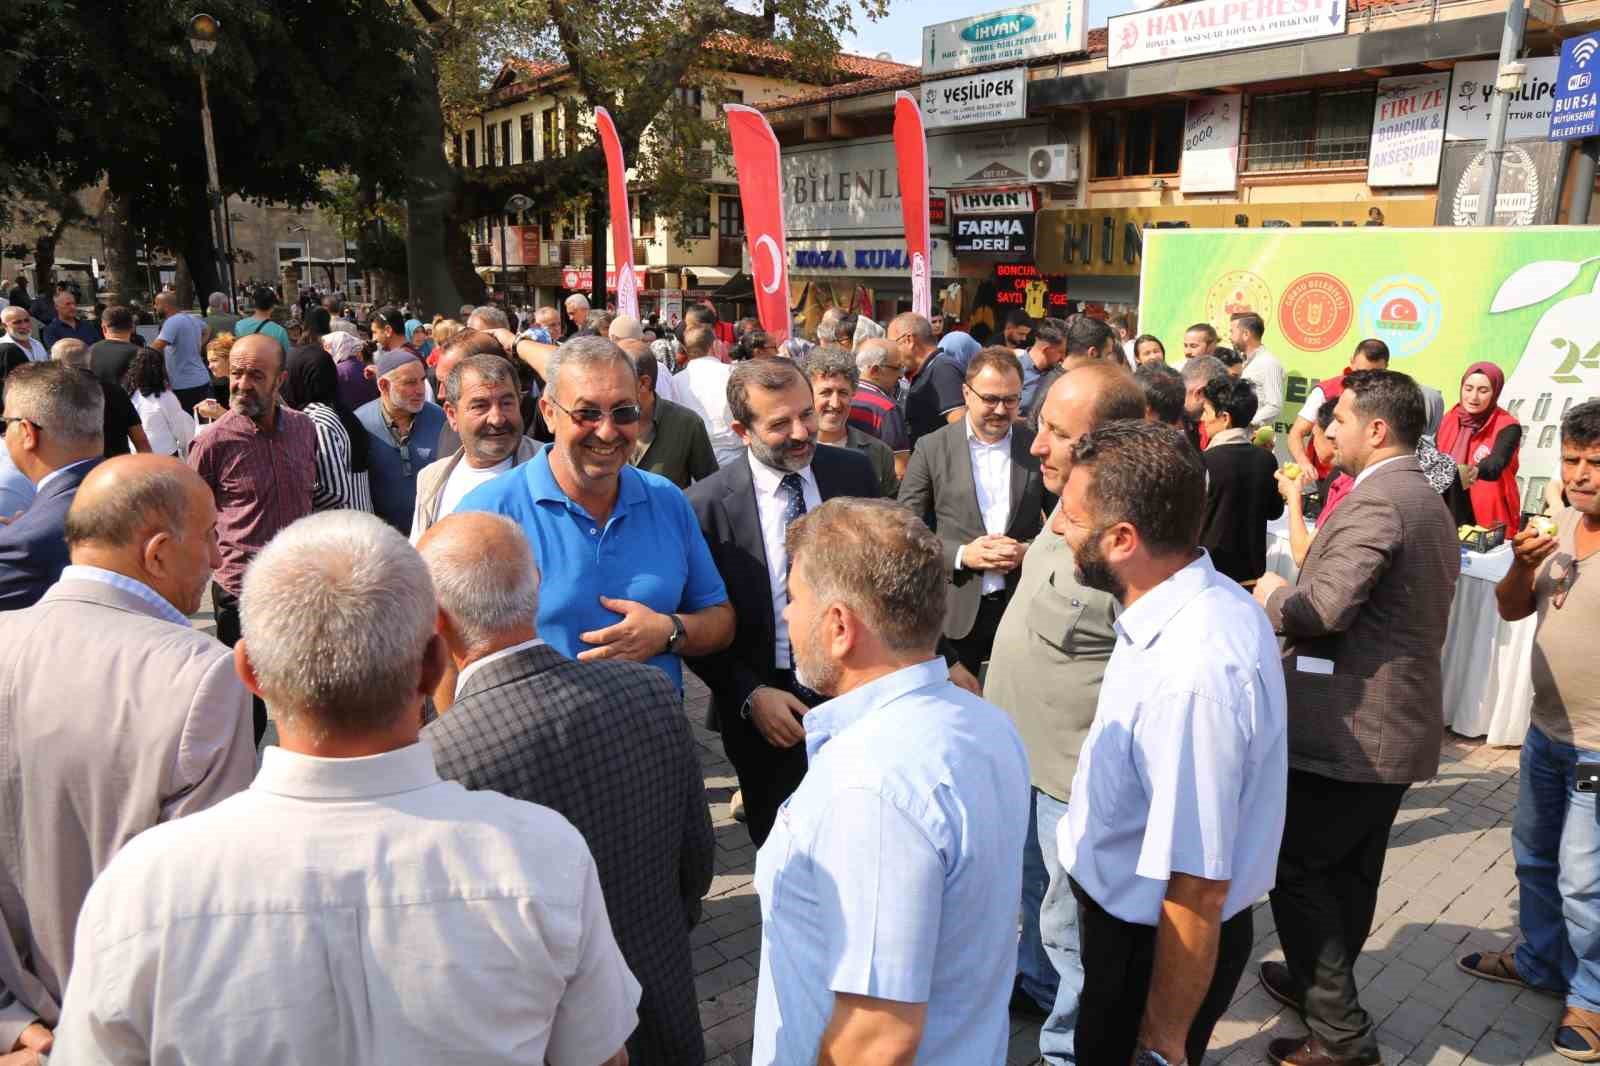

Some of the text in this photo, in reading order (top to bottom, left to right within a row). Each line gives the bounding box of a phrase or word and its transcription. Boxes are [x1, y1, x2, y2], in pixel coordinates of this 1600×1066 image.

[975, 20, 1020, 40] İHVAN
[943, 79, 1014, 105] YEŞİLİPEK
[1555, 92, 1597, 112] BURSA
[1430, 113, 1440, 129] &
[958, 220, 1024, 235] FARMA
[972, 236, 1009, 250] DERİ
[795, 250, 847, 269] KOZA
